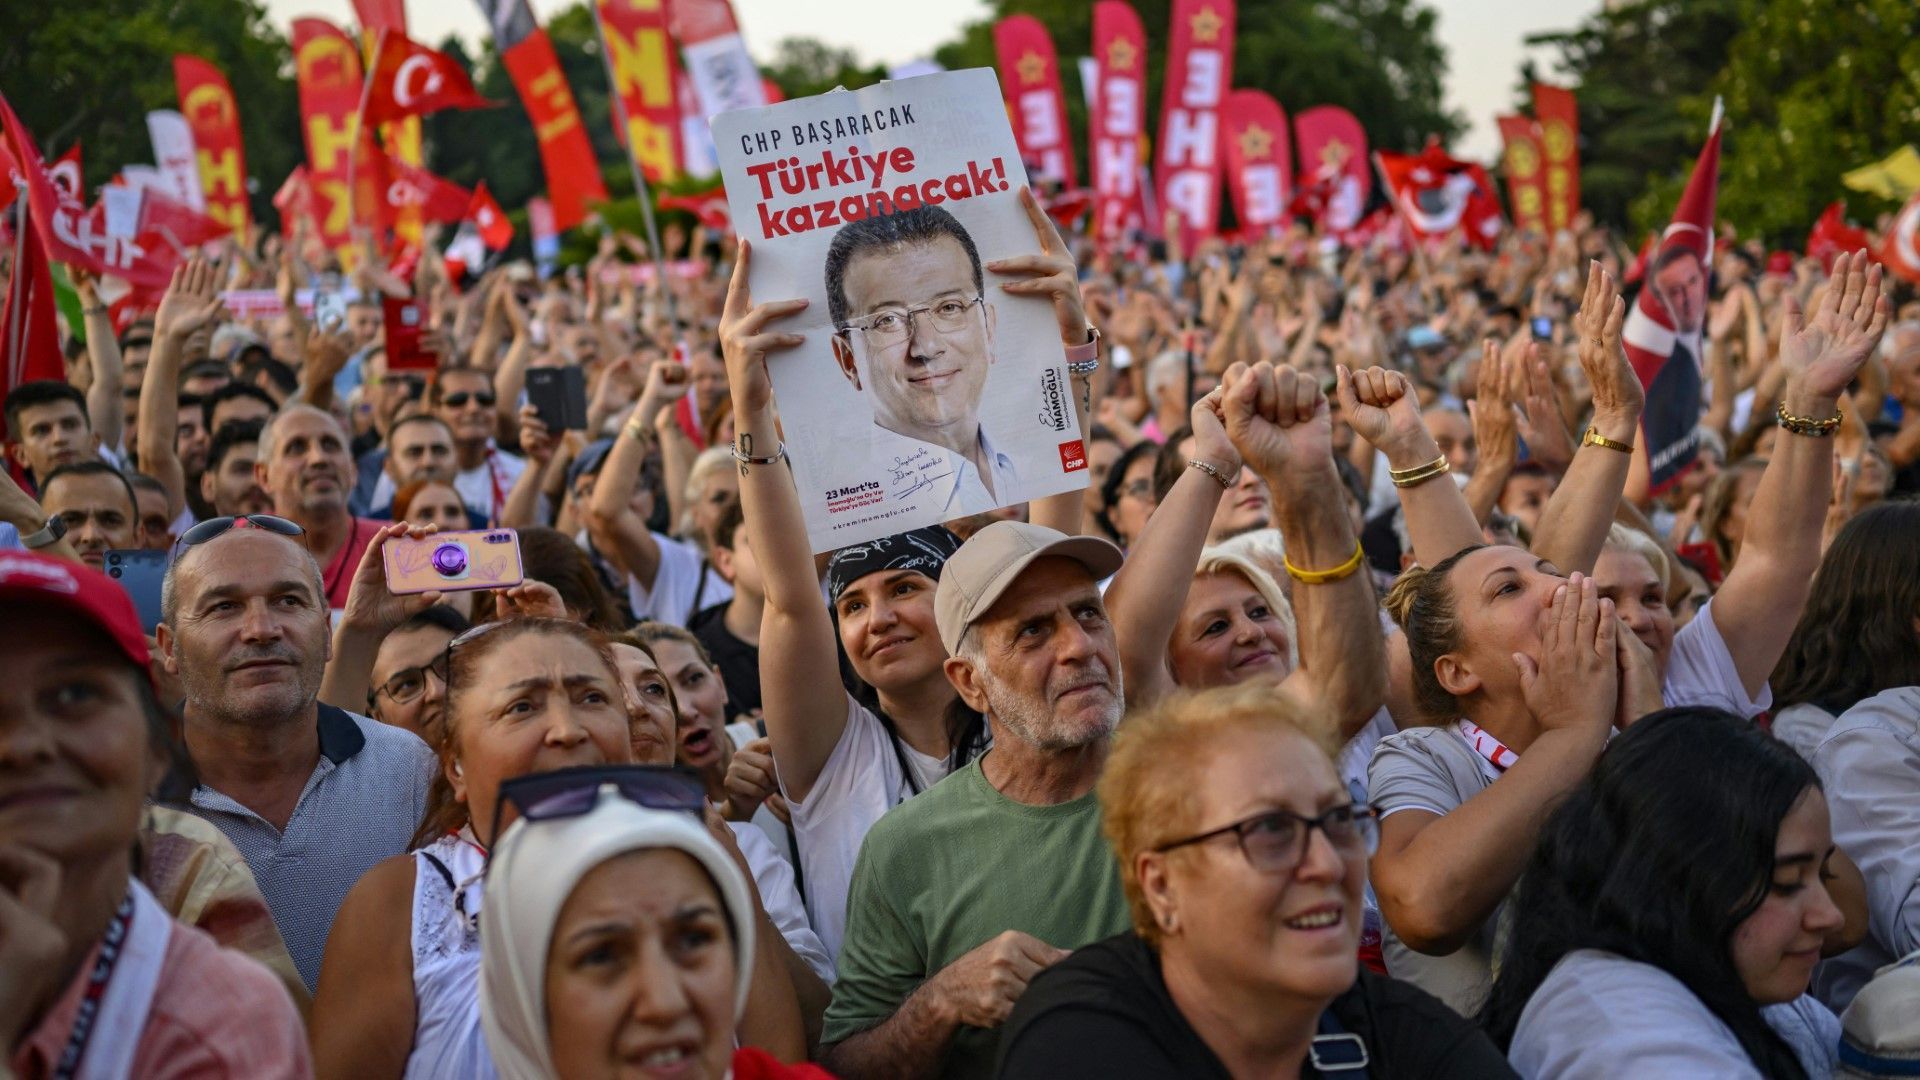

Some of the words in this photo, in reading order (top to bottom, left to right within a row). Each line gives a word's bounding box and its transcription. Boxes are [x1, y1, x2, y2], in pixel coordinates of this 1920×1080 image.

[741, 130, 782, 156] CHP
[792, 104, 916, 145] BAŞARACAK
[746, 145, 916, 200] Türkiye
[756, 157, 1010, 240] kazanacak!
[1045, 368, 1066, 432] İMAMOĞLU
[1065, 458, 1084, 469] CHP
[825, 490, 838, 500] 23
[839, 481, 880, 497] Mart'ta
